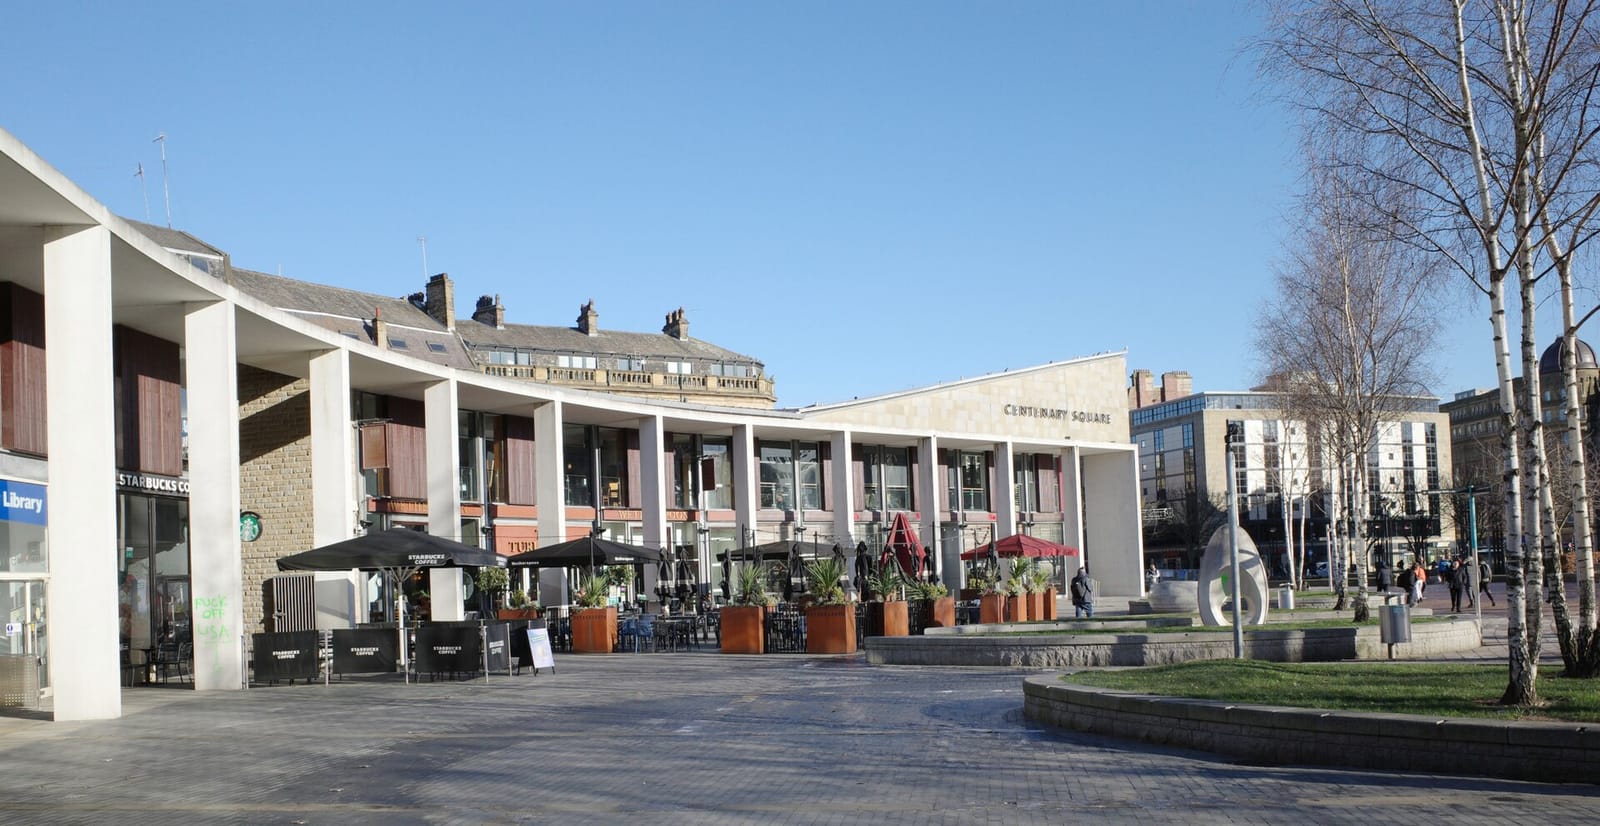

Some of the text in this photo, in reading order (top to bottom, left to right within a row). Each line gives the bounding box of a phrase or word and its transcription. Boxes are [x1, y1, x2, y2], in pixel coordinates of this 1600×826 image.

[1004, 404, 1111, 424] CENTENARY SQUARE
[119, 473, 177, 491] STARBUCKS
[3, 490, 43, 514] Library
[408, 553, 445, 561] STARBUCKS
[202, 609, 225, 620] OFF
